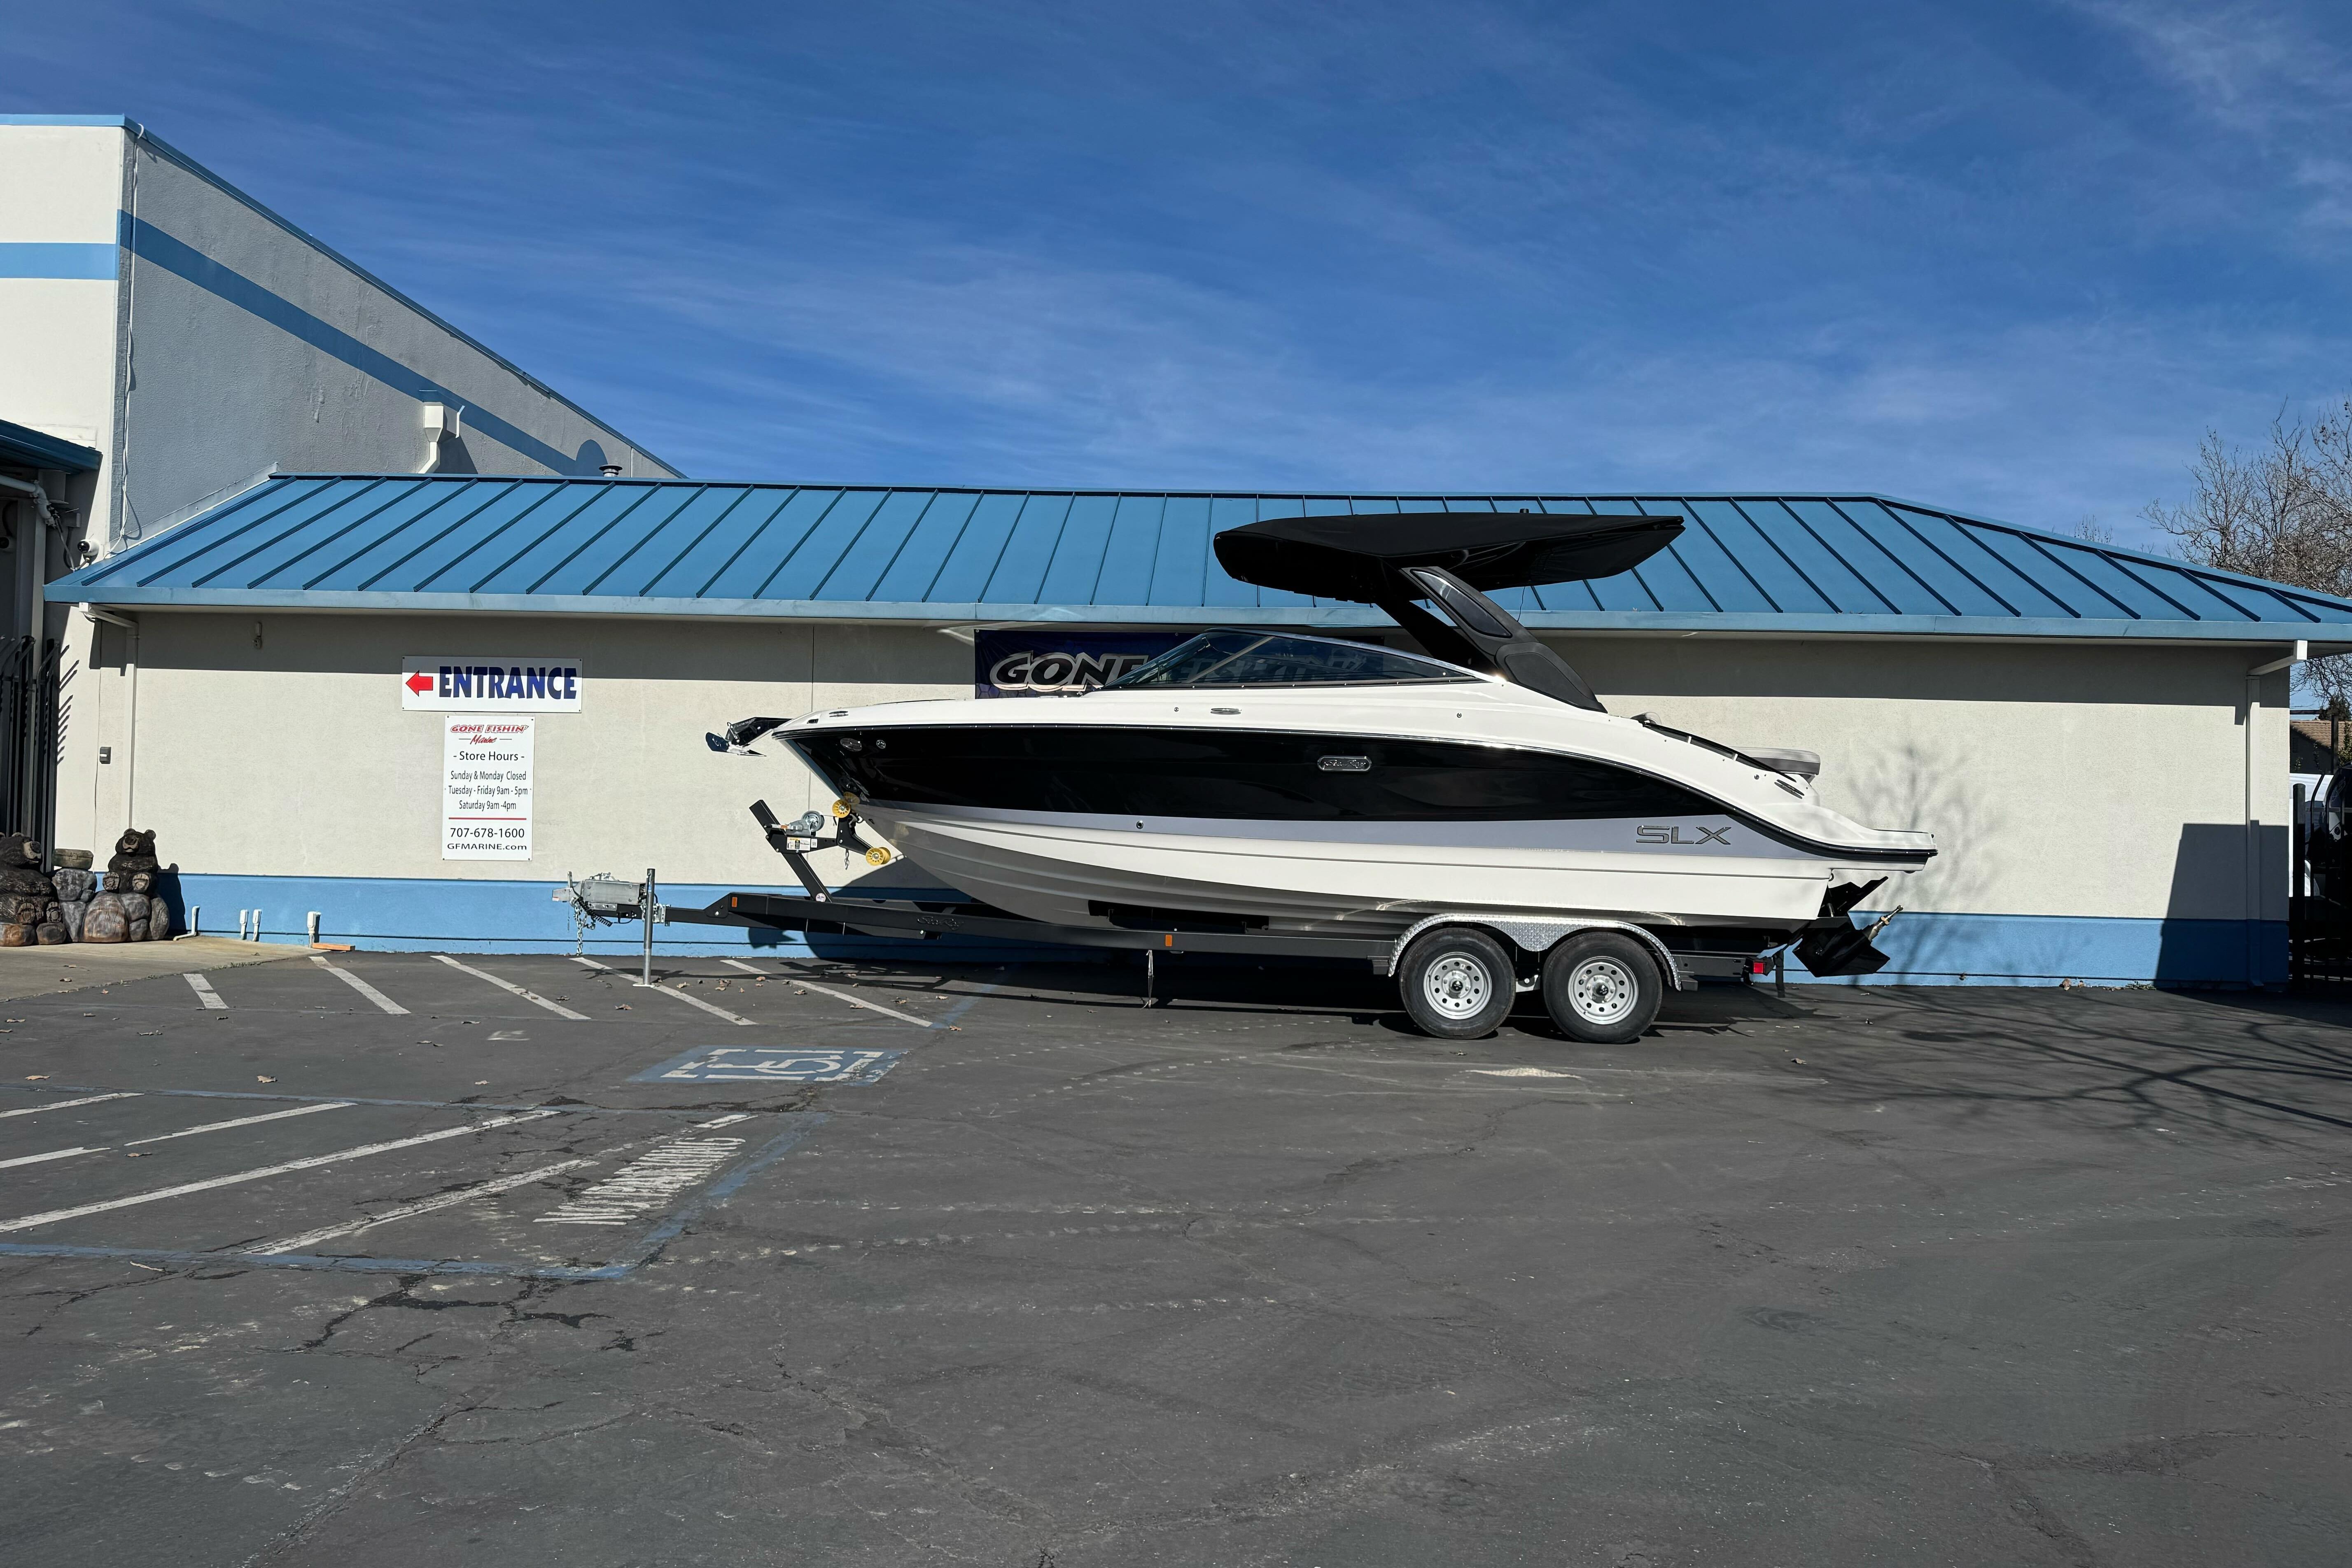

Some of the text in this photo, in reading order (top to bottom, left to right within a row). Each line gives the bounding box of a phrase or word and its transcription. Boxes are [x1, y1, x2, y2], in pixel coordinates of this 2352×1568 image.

[439, 666, 577, 700] ENTRANCE
[450, 725, 484, 733] GONE
[470, 734, 497, 744] Marine
[460, 751, 485, 761] Store
[489, 751, 518, 761] Hours
[450, 770, 526, 782] Sunday & Monday Closed
[448, 785, 472, 797] Tuesday
[477, 785, 495, 797] Friday
[497, 786, 509, 795] 9am
[514, 786, 528, 797] 5pm
[459, 800, 485, 812] Saturday
[487, 800, 499, 809] 9am
[450, 828, 525, 838] 707-678-1600
[1636, 825, 1731, 845] SLX
